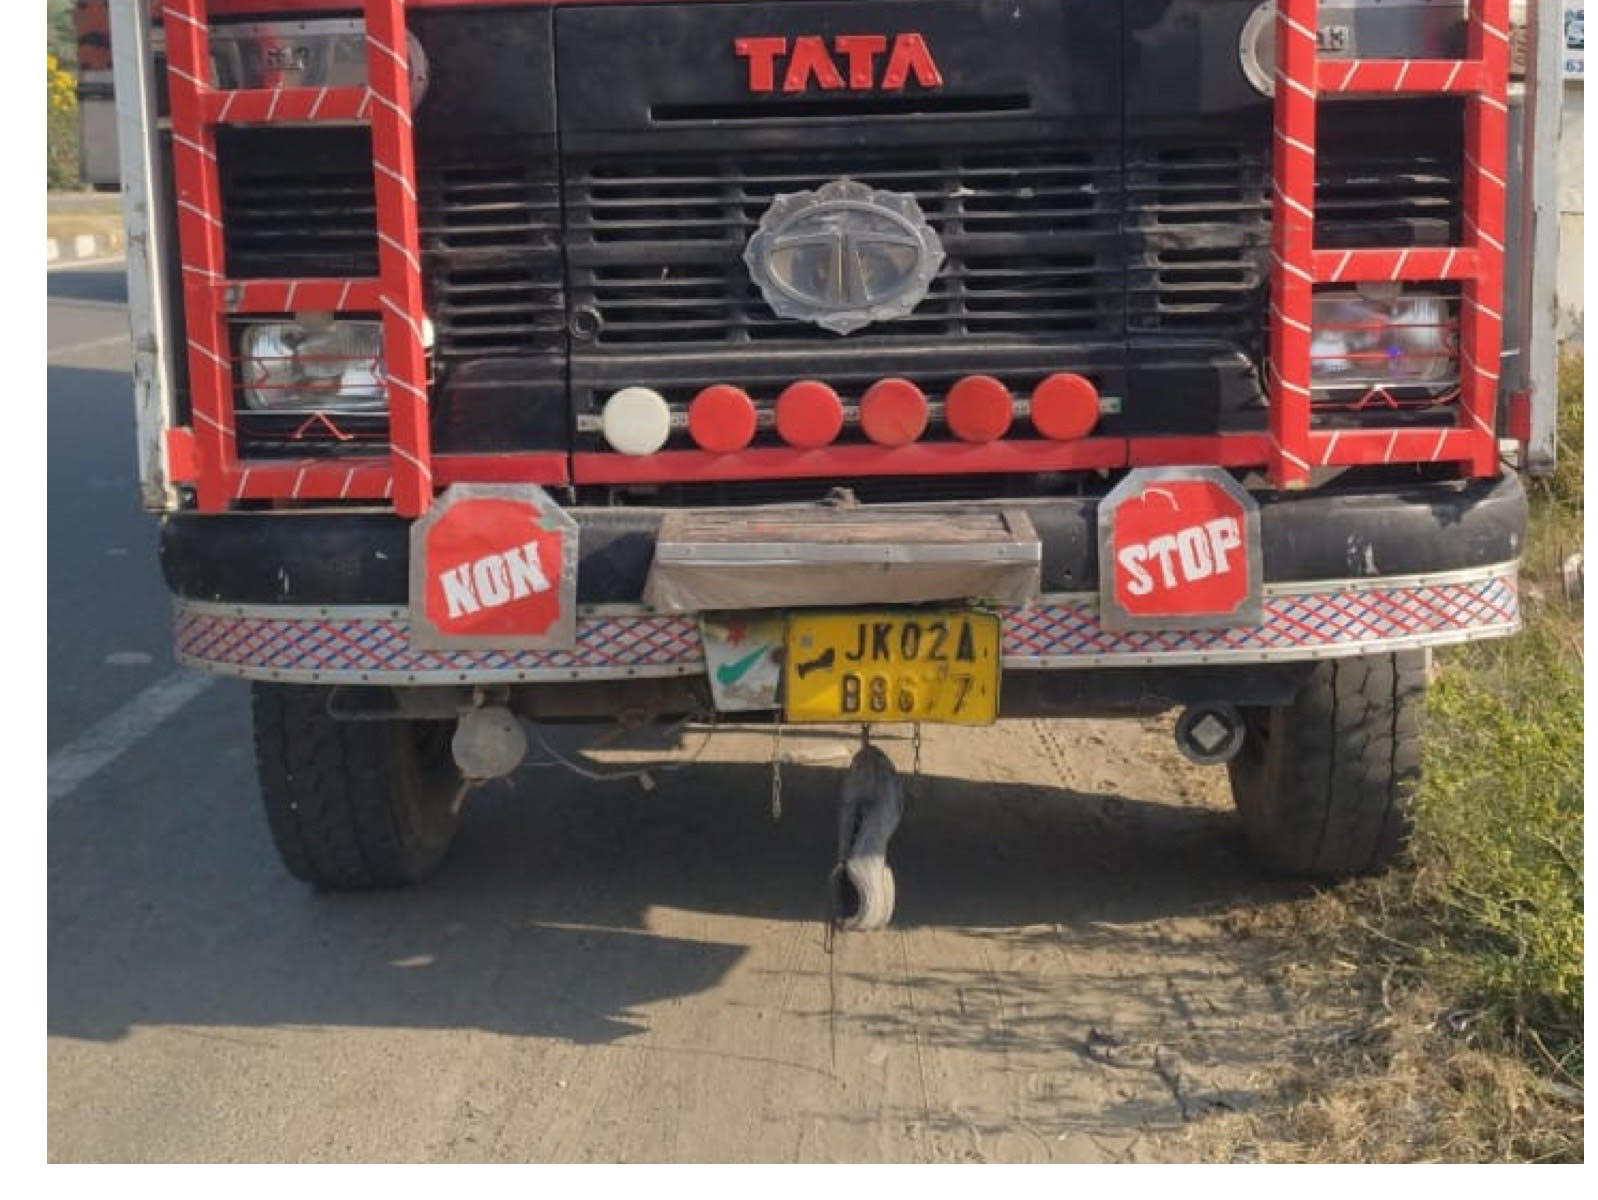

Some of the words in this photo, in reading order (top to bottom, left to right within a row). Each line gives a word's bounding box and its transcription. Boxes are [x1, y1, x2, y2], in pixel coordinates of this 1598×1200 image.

[734, 33, 943, 92] TATA
[439, 541, 551, 619] NON
[1118, 516, 1242, 596] STOP
[845, 621, 976, 663] JK02A
[842, 671, 971, 715] B867
